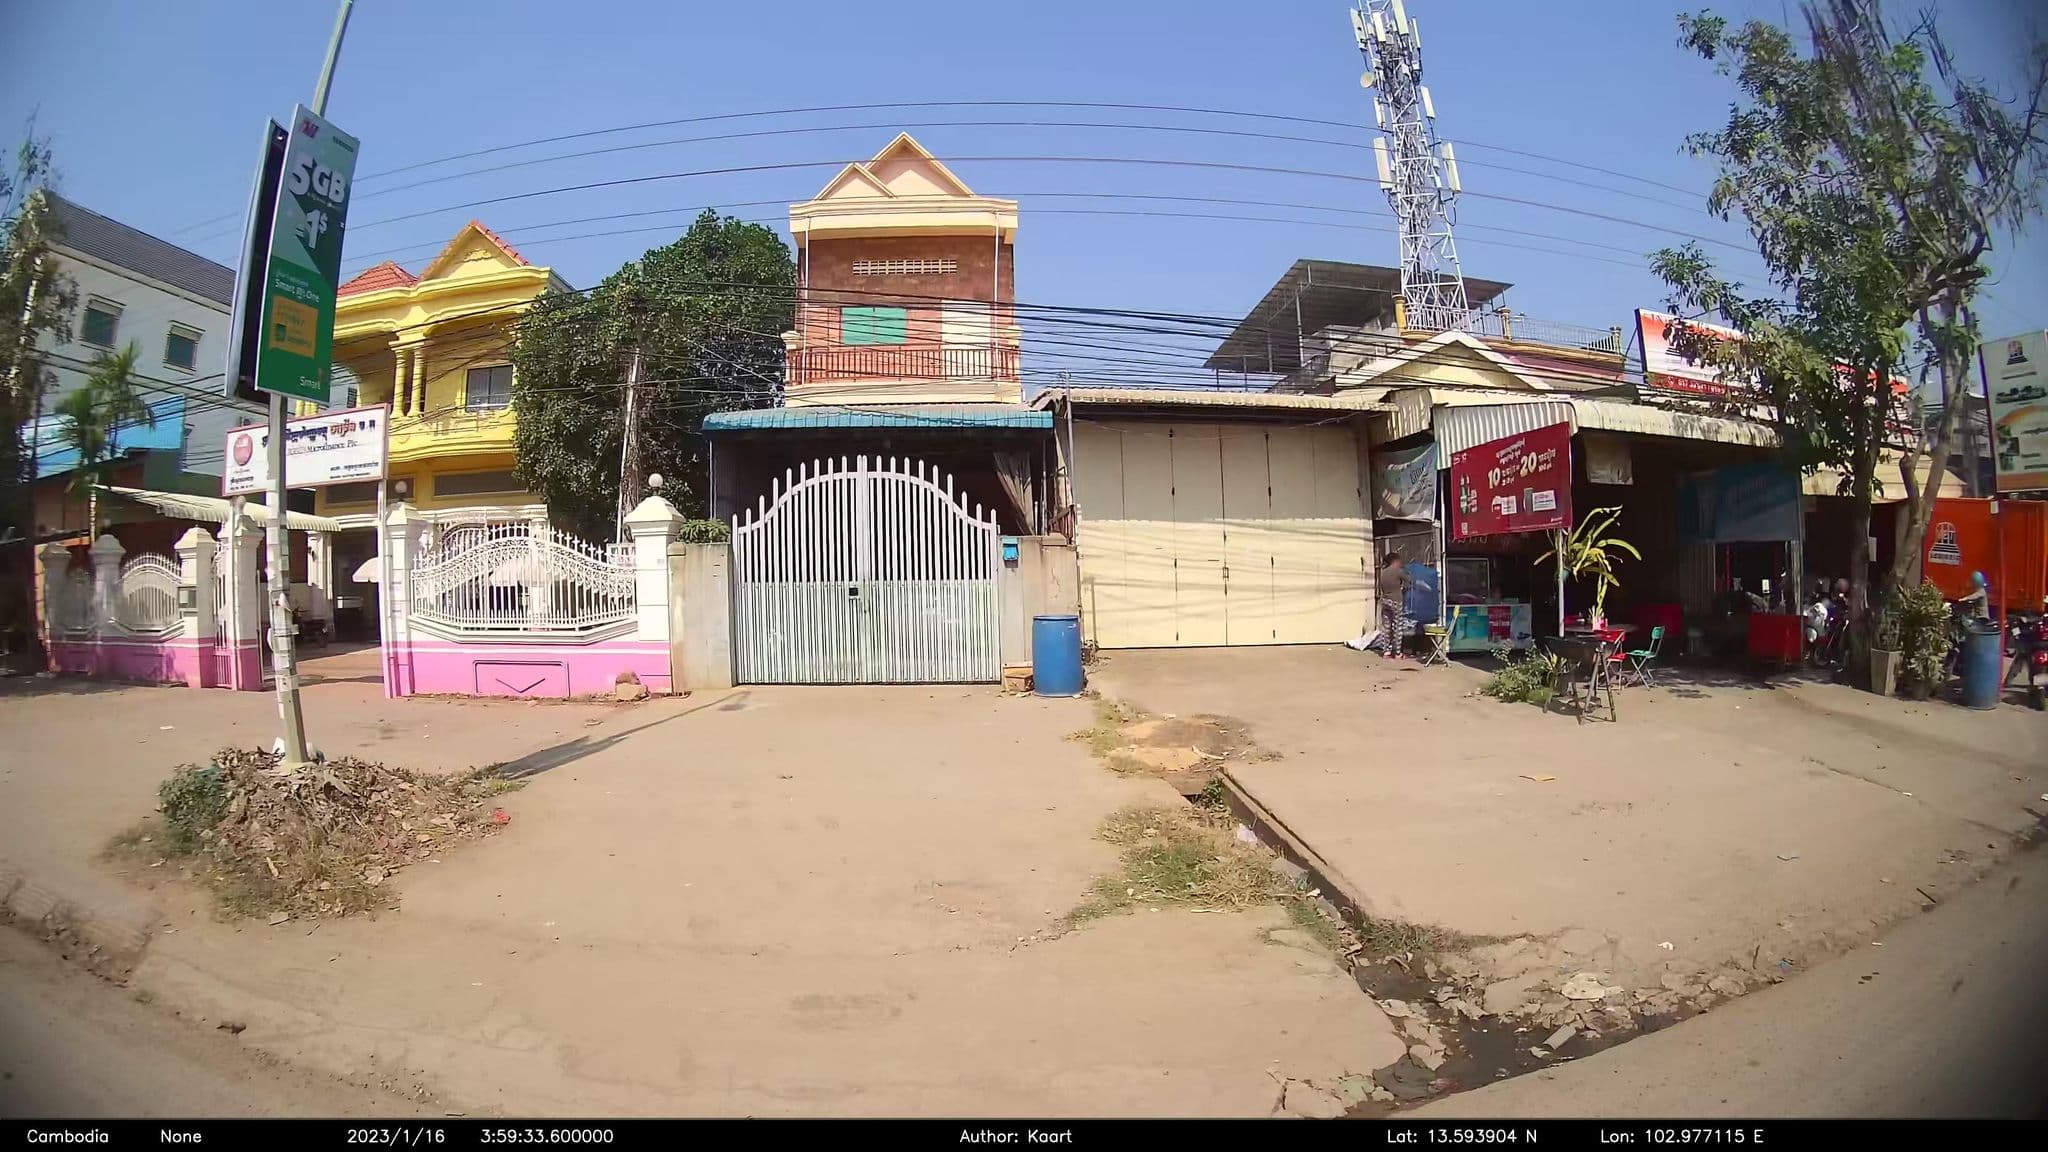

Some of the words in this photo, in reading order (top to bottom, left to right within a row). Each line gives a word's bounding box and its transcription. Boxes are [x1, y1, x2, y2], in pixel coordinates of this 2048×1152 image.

[288, 152, 347, 204] 5GB
[299, 375, 321, 391] Smart
[1487, 467, 1501, 489] 10
[1519, 451, 1538, 478] 20
